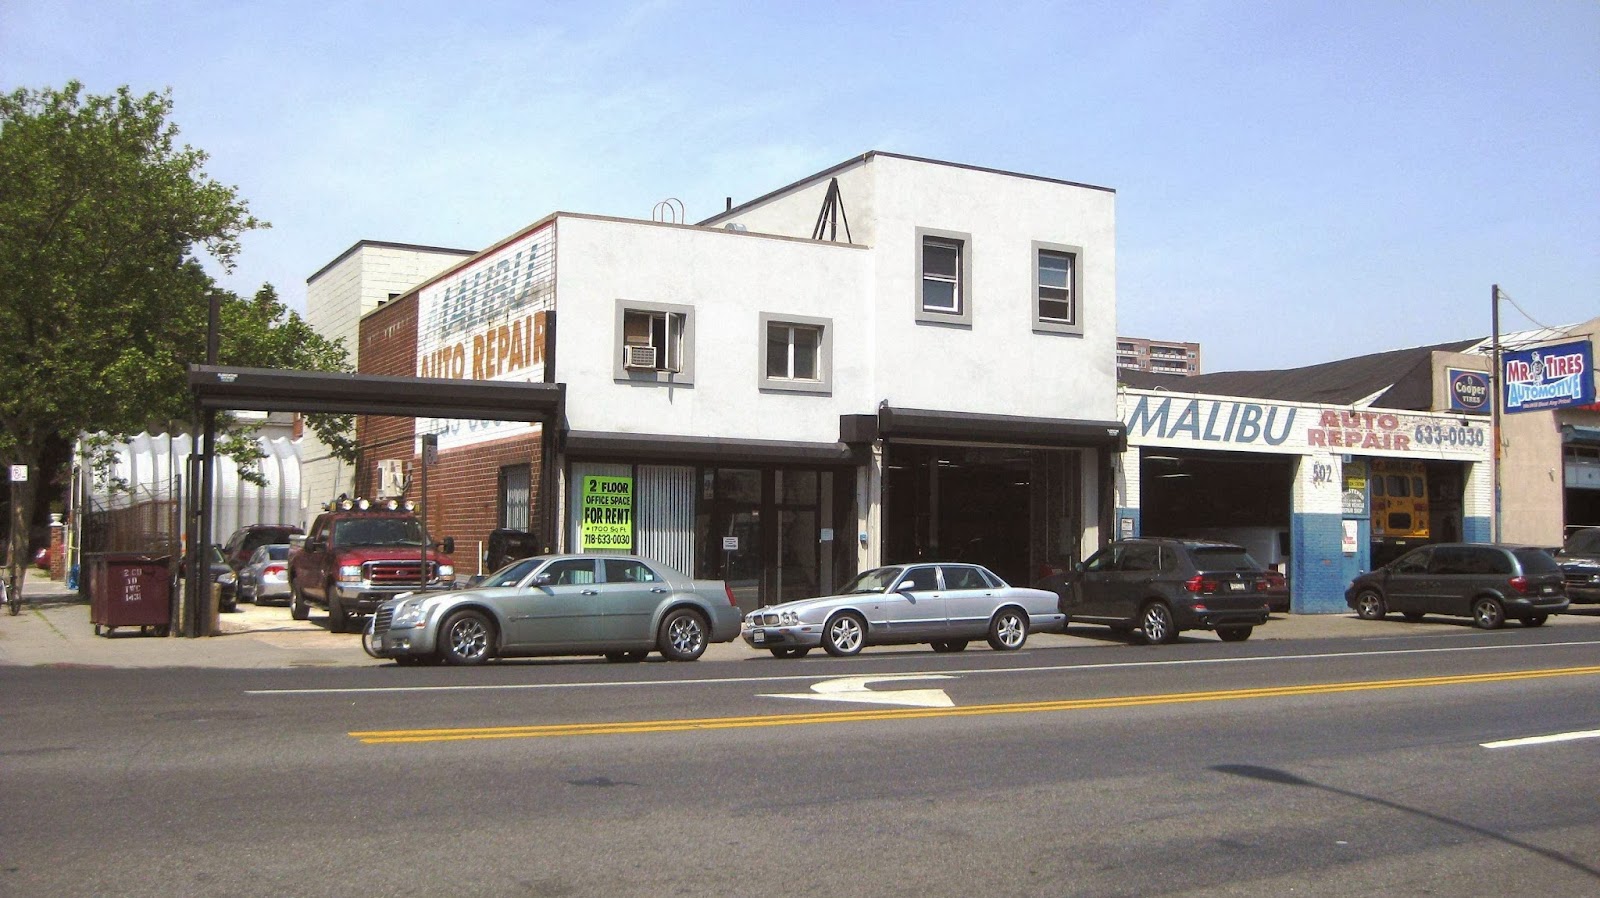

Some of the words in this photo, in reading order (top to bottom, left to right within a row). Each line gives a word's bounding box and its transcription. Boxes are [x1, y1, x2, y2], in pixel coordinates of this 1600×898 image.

[421, 342, 465, 379] AUTO
[472, 311, 546, 381] REPAIR
[1544, 353, 1583, 379] TIRES
[1455, 380, 1486, 395] Cooper
[1507, 374, 1581, 407] AUTOMOTIVE
[1127, 395, 1297, 446] MALIBU
[1319, 410, 1399, 430] AUTO
[1308, 429, 1411, 450] REPAIR
[1415, 425, 1484, 447] 633-0030
[1313, 464, 1332, 482] 502
[590, 479, 597, 492] 2
[601, 482, 628, 493] FLOOR
[586, 495, 609, 504] OFFICE
[610, 496, 630, 505] SPACE
[585, 507, 602, 524] FOR
[605, 508, 629, 524] RENT
[584, 534, 630, 544] 718-633-0030
